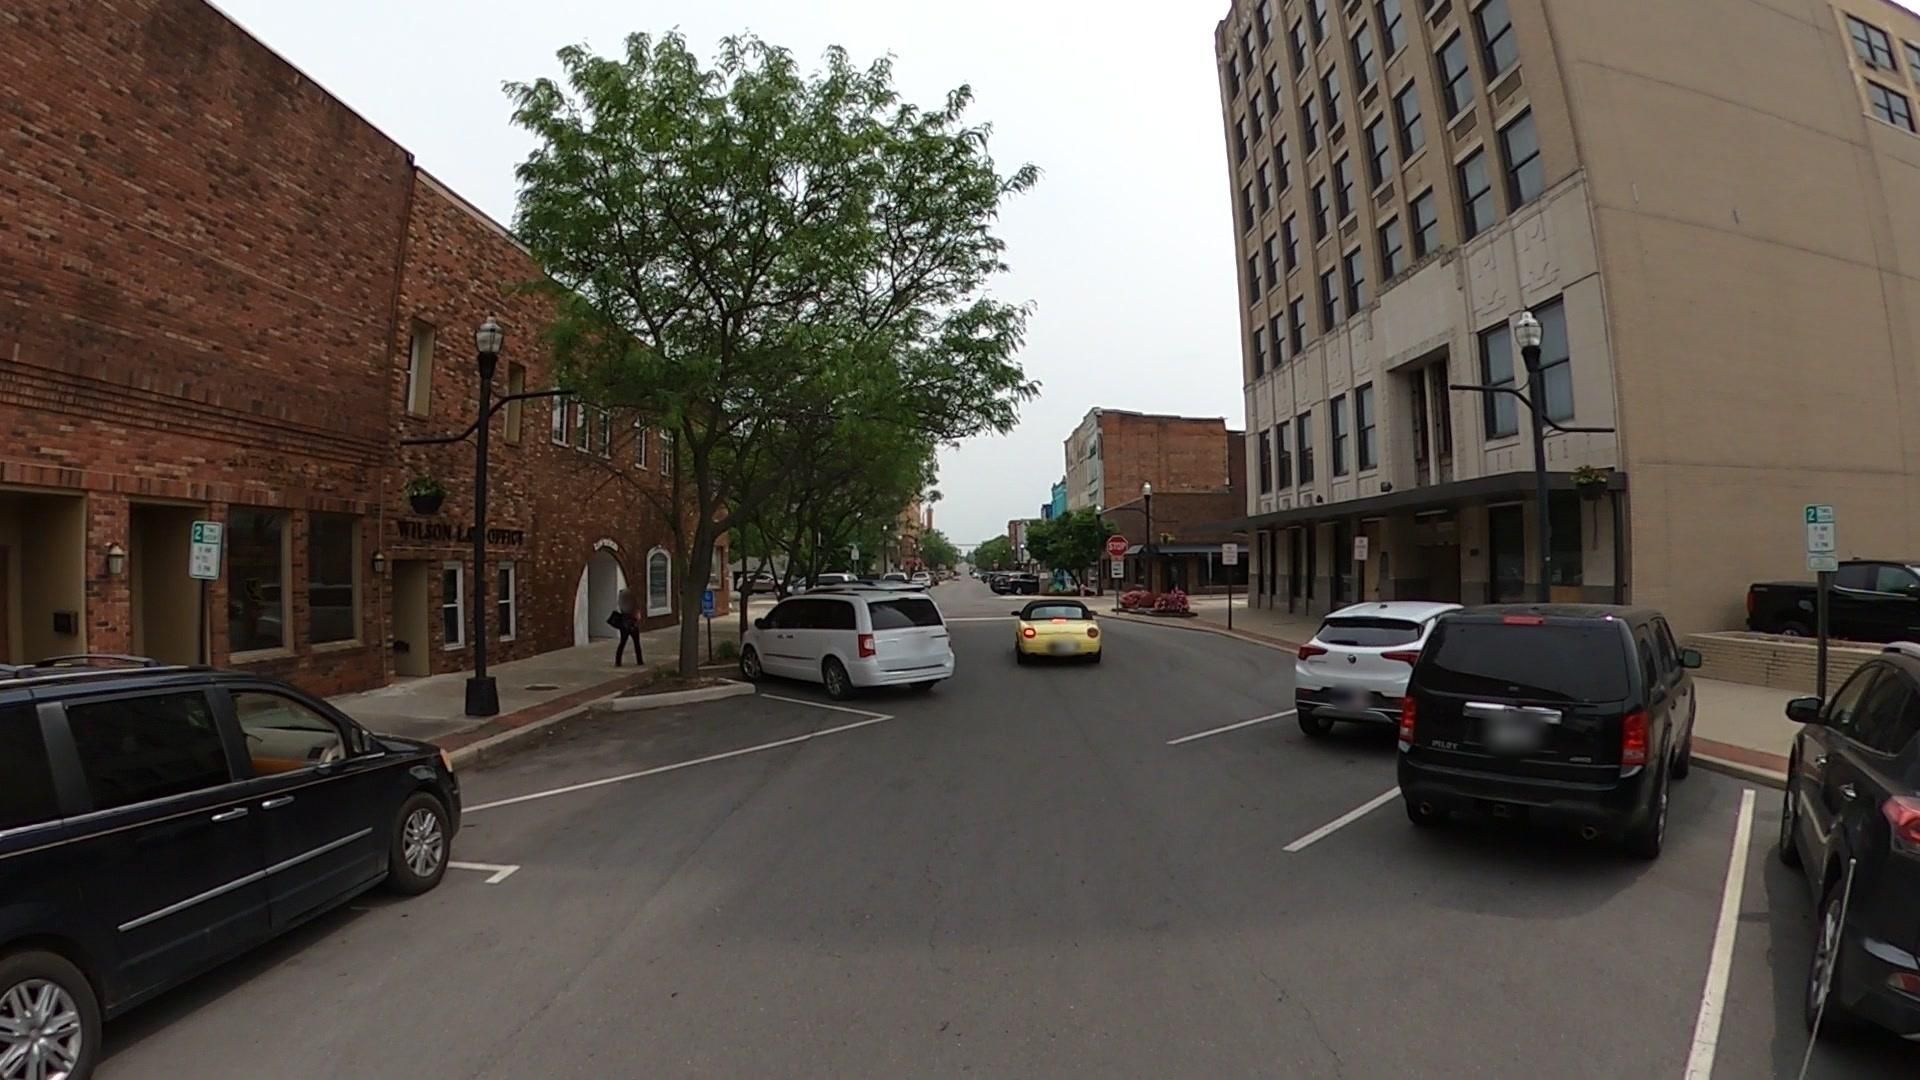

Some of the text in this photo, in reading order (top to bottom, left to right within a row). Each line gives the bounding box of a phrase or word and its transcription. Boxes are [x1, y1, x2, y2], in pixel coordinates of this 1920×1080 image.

[1807, 508, 1817, 521] 2
[194, 525, 202, 540] 2
[398, 520, 452, 541] WILSON
[487, 528, 524, 545] OFFICE
[1108, 541, 1127, 551] STOP
[1431, 740, 1458, 750] PILOT
